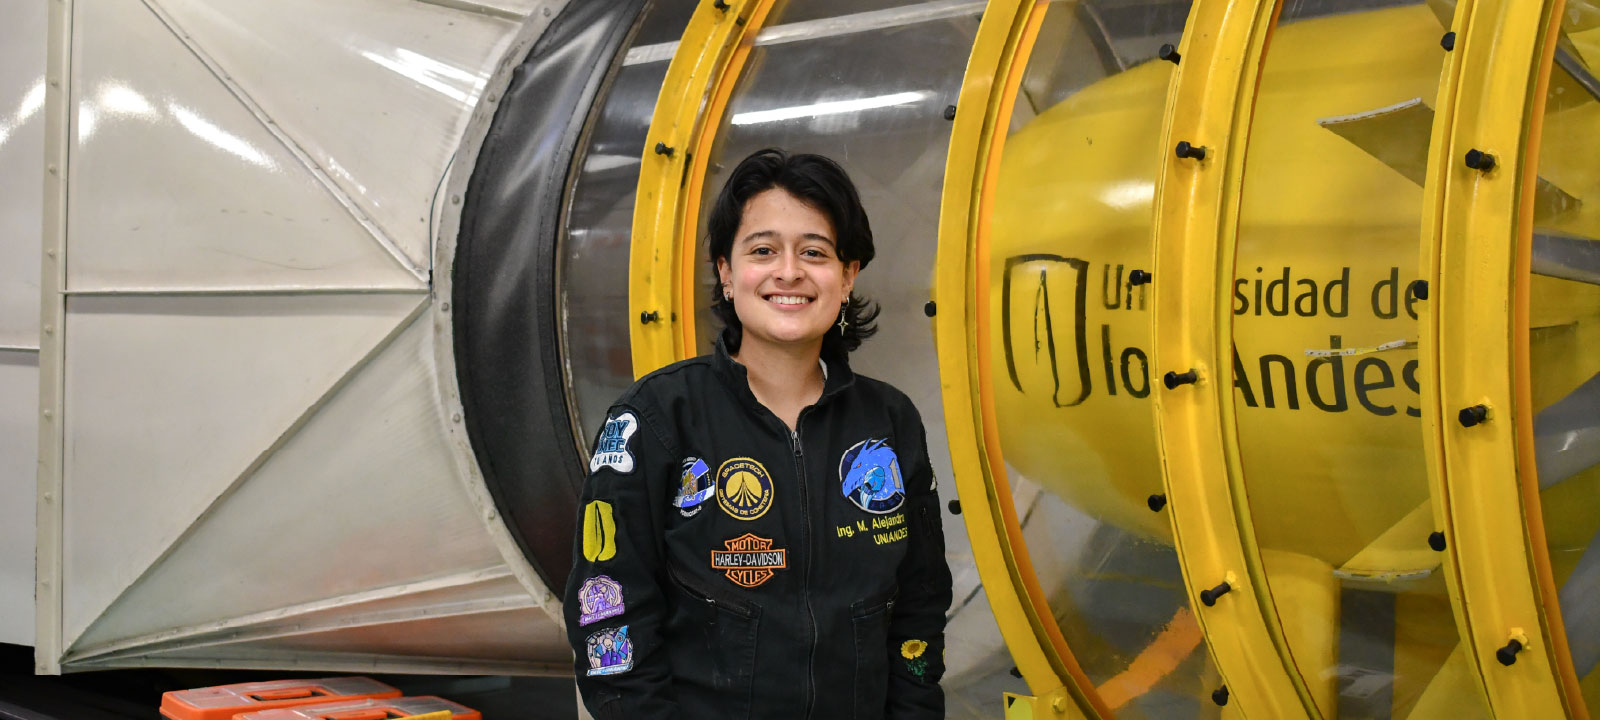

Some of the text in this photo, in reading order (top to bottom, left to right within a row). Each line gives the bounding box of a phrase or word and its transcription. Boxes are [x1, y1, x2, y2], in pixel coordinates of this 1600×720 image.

[1102, 264, 1351, 319] Unsidad
[1101, 324, 1152, 399] lo
[604, 419, 630, 439] OY
[721, 462, 765, 478] SPACETECH
[856, 519, 869, 532] M.
[872, 512, 905, 530] Alejandr
[731, 537, 767, 551] MOTOR
[873, 526, 908, 546] UNIANDES
[714, 551, 784, 567] HARLEY-DAVIDSON
[730, 569, 768, 585] CYCLES
